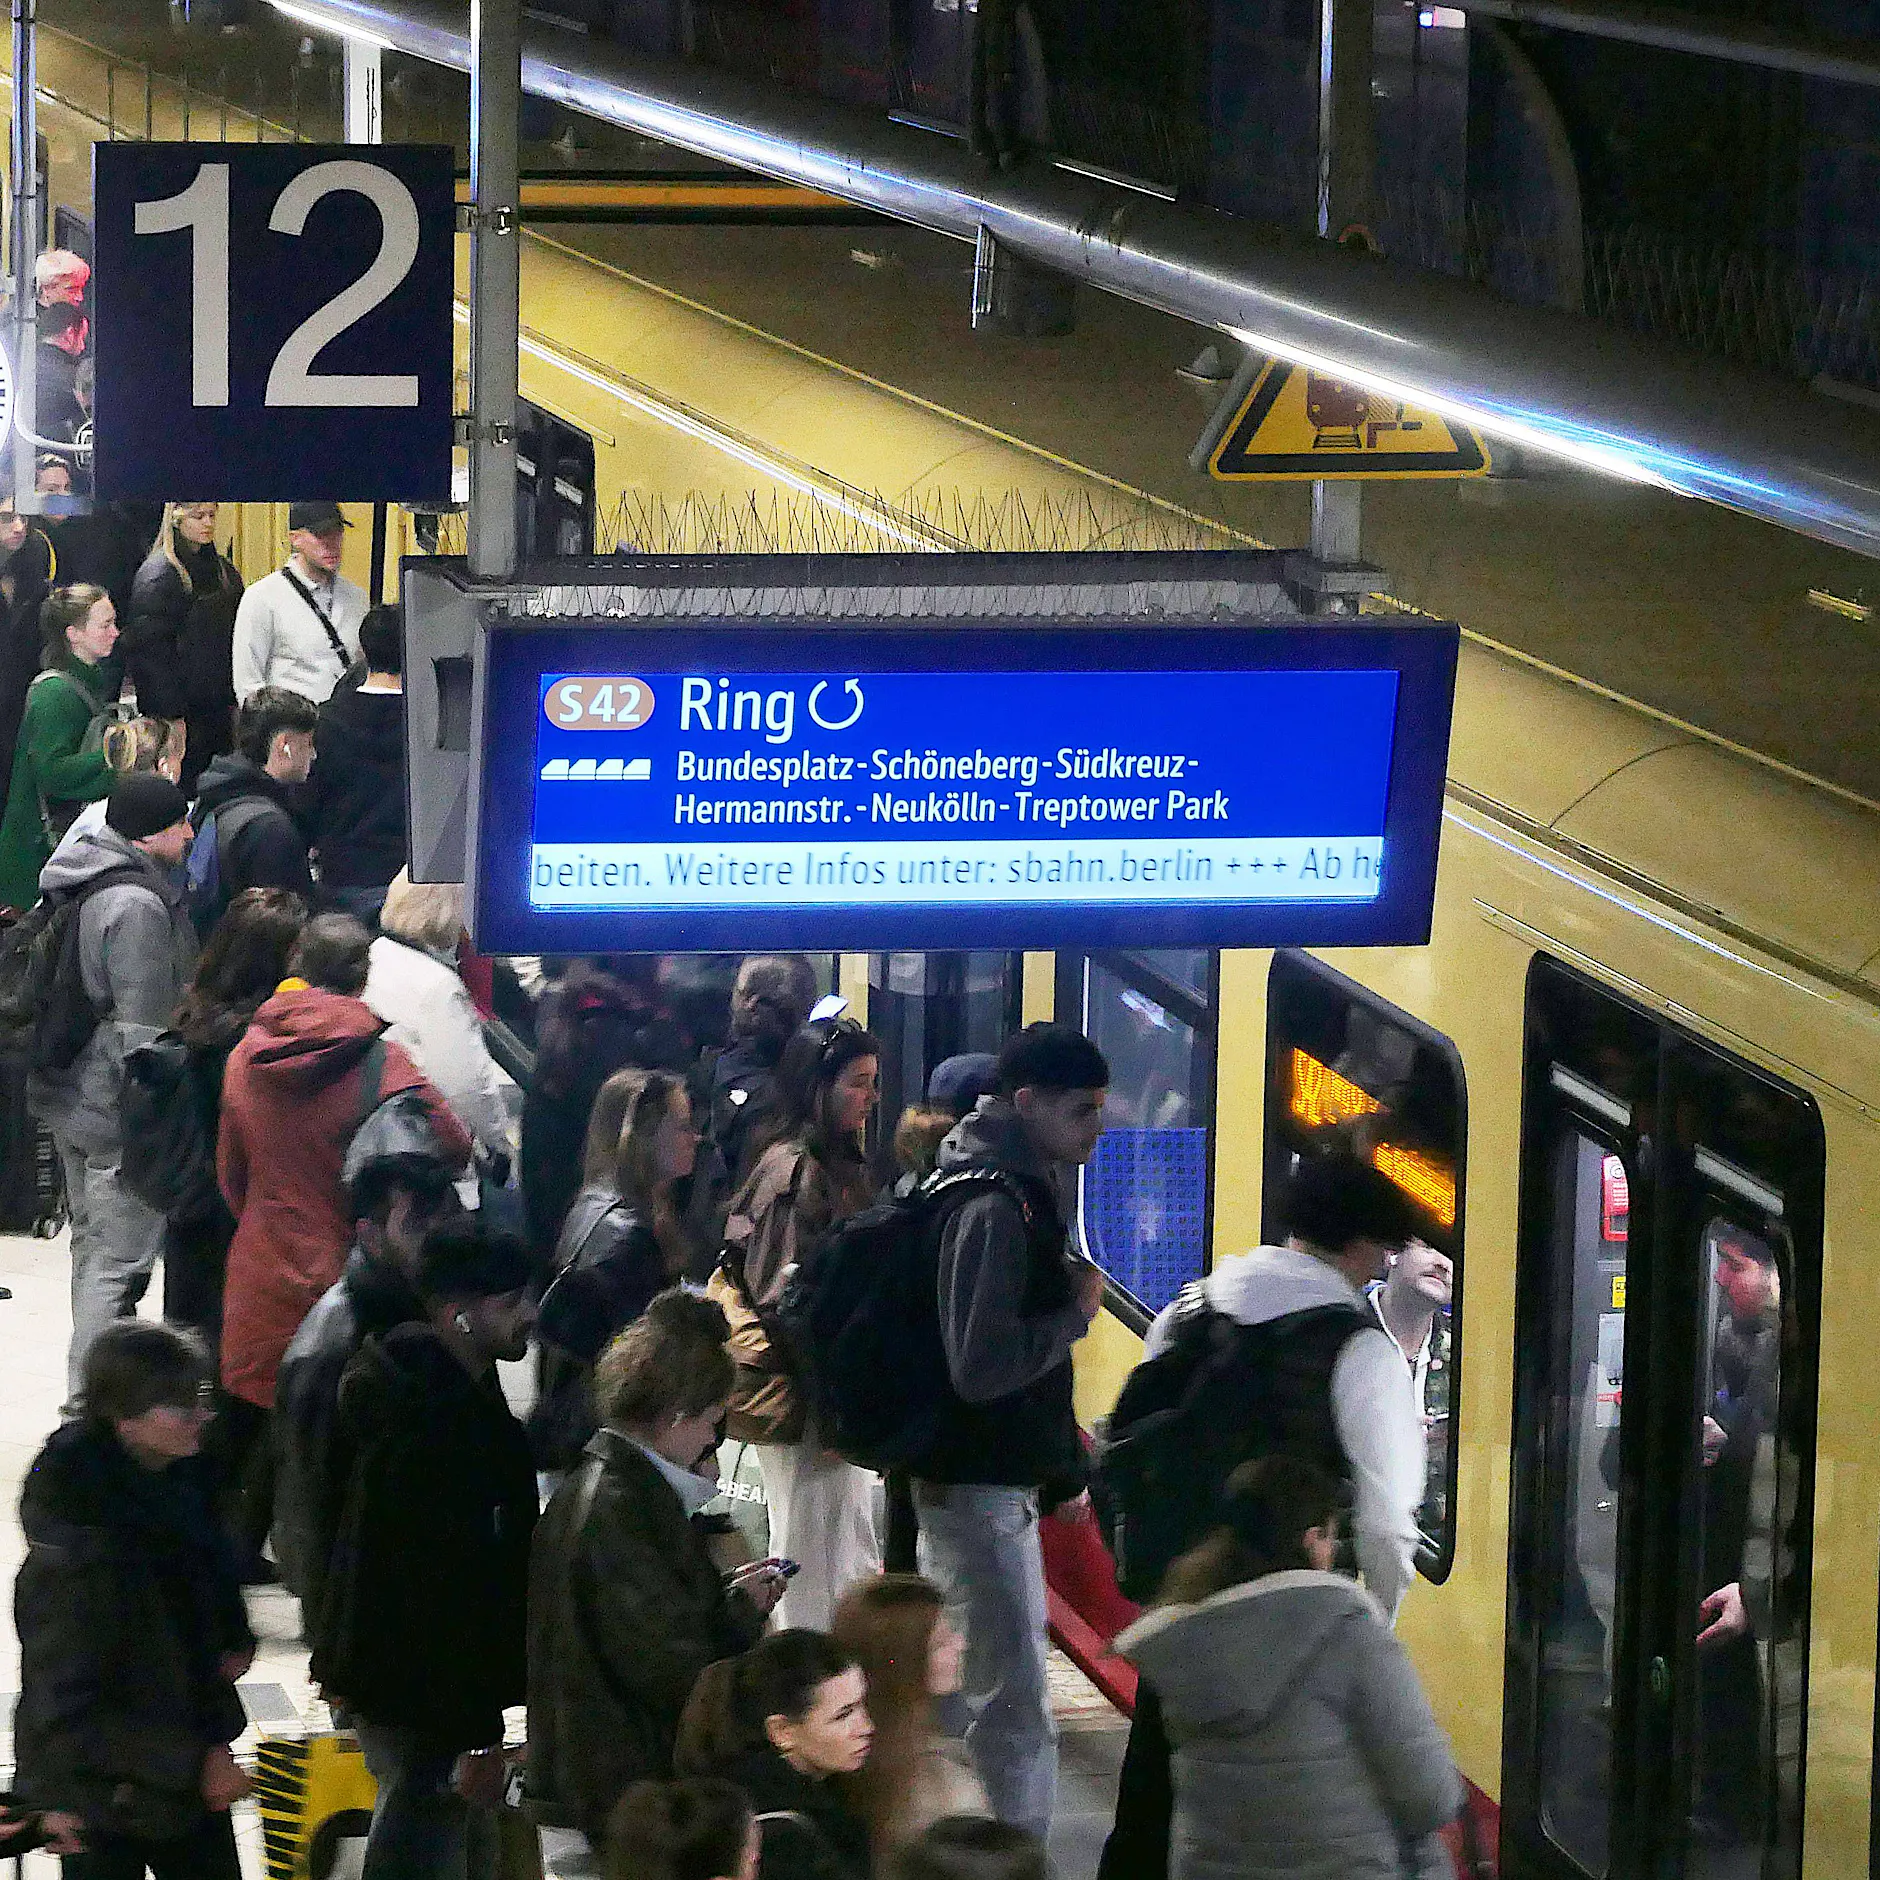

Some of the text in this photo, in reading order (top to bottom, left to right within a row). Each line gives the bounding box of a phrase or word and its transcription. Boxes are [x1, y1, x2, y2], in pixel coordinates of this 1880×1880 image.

[134, 159, 420, 407] 12
[680, 677, 795, 744] Ring
[1167, 789, 1230, 820] Park
[536, 853, 651, 887] beiten.
[664, 852, 793, 886] Weitere
[804, 851, 886, 886] Infos
[899, 854, 997, 885] unter:
[1007, 849, 1212, 883] sbahn.berlin
[1299, 847, 1342, 881] Ab
